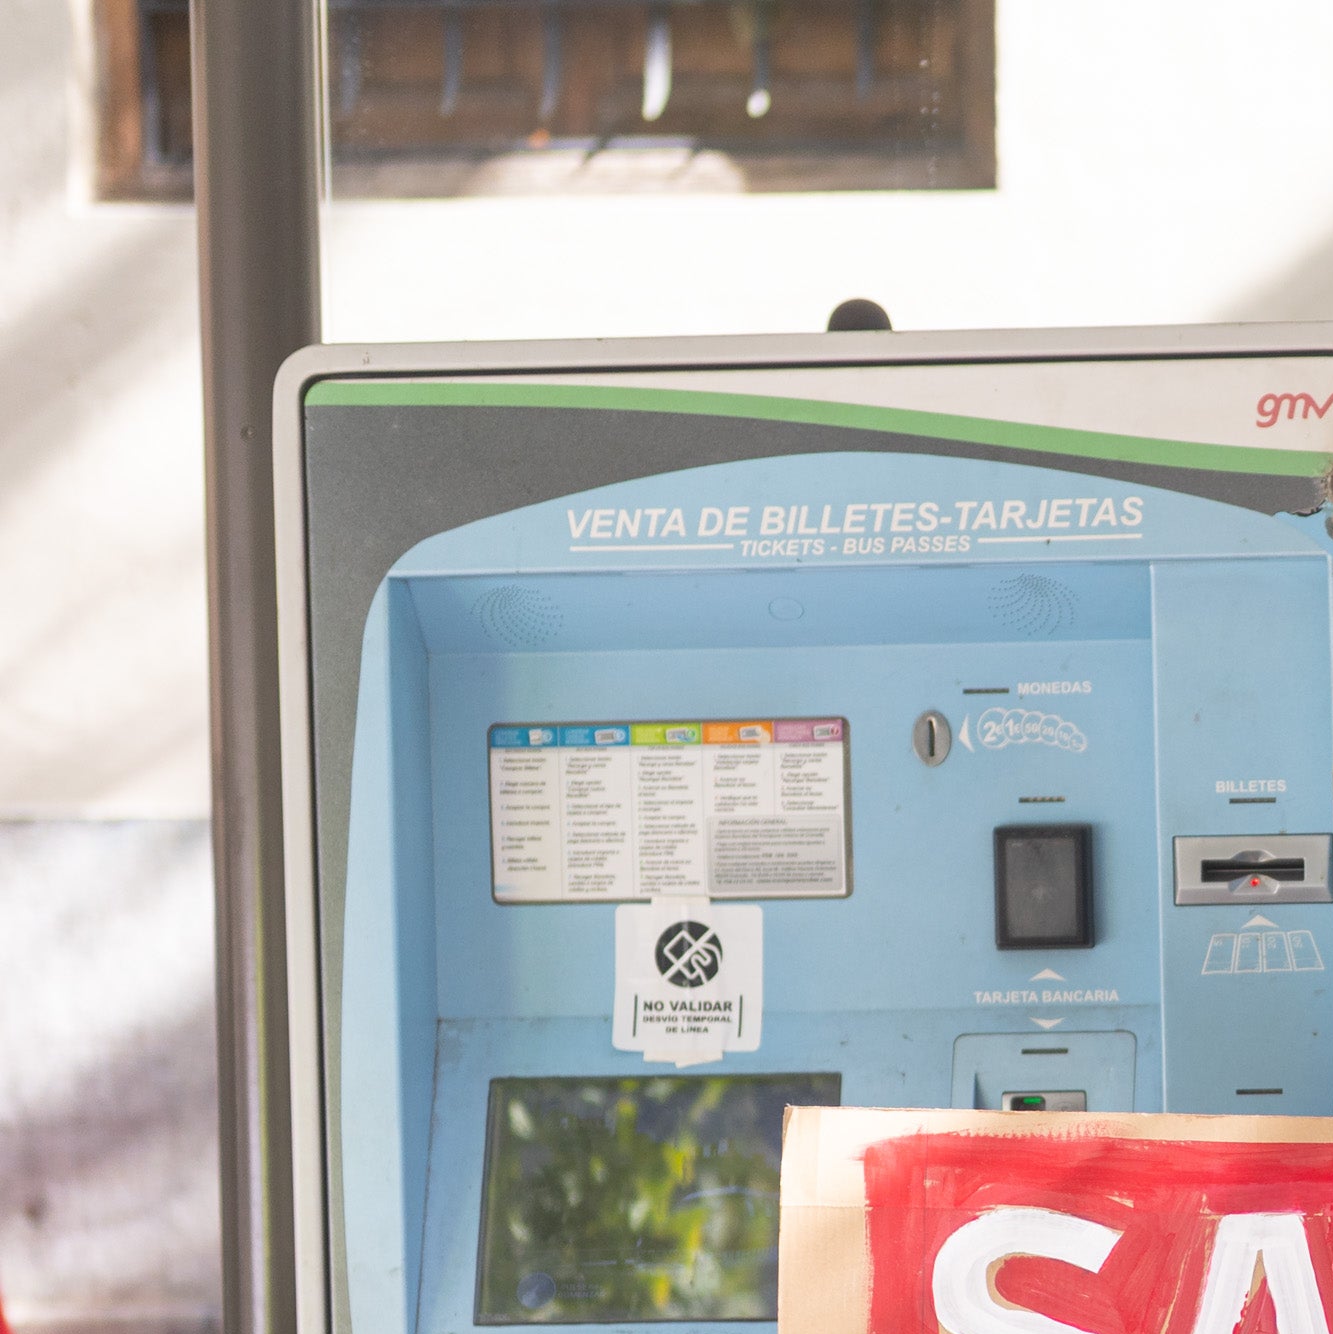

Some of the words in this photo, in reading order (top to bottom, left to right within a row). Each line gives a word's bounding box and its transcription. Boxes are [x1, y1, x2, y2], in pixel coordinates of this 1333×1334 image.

[568, 508, 685, 538] VENTA
[698, 507, 749, 536] DE
[761, 497, 1143, 534] BILLETES-TARJETAS
[741, 538, 824, 557] TICKETS
[843, 537, 884, 554] BUS
[891, 535, 970, 552] PASSES
[1018, 681, 1091, 694] MONEDAS
[1216, 780, 1286, 793] BILLETES
[974, 991, 1038, 1003] TARJETA
[1042, 989, 1119, 1002] BANCARIA
[643, 1001, 664, 1012] NO
[670, 1001, 733, 1012] VALIDAR
[682, 1014, 732, 1023] TEMPORAL
